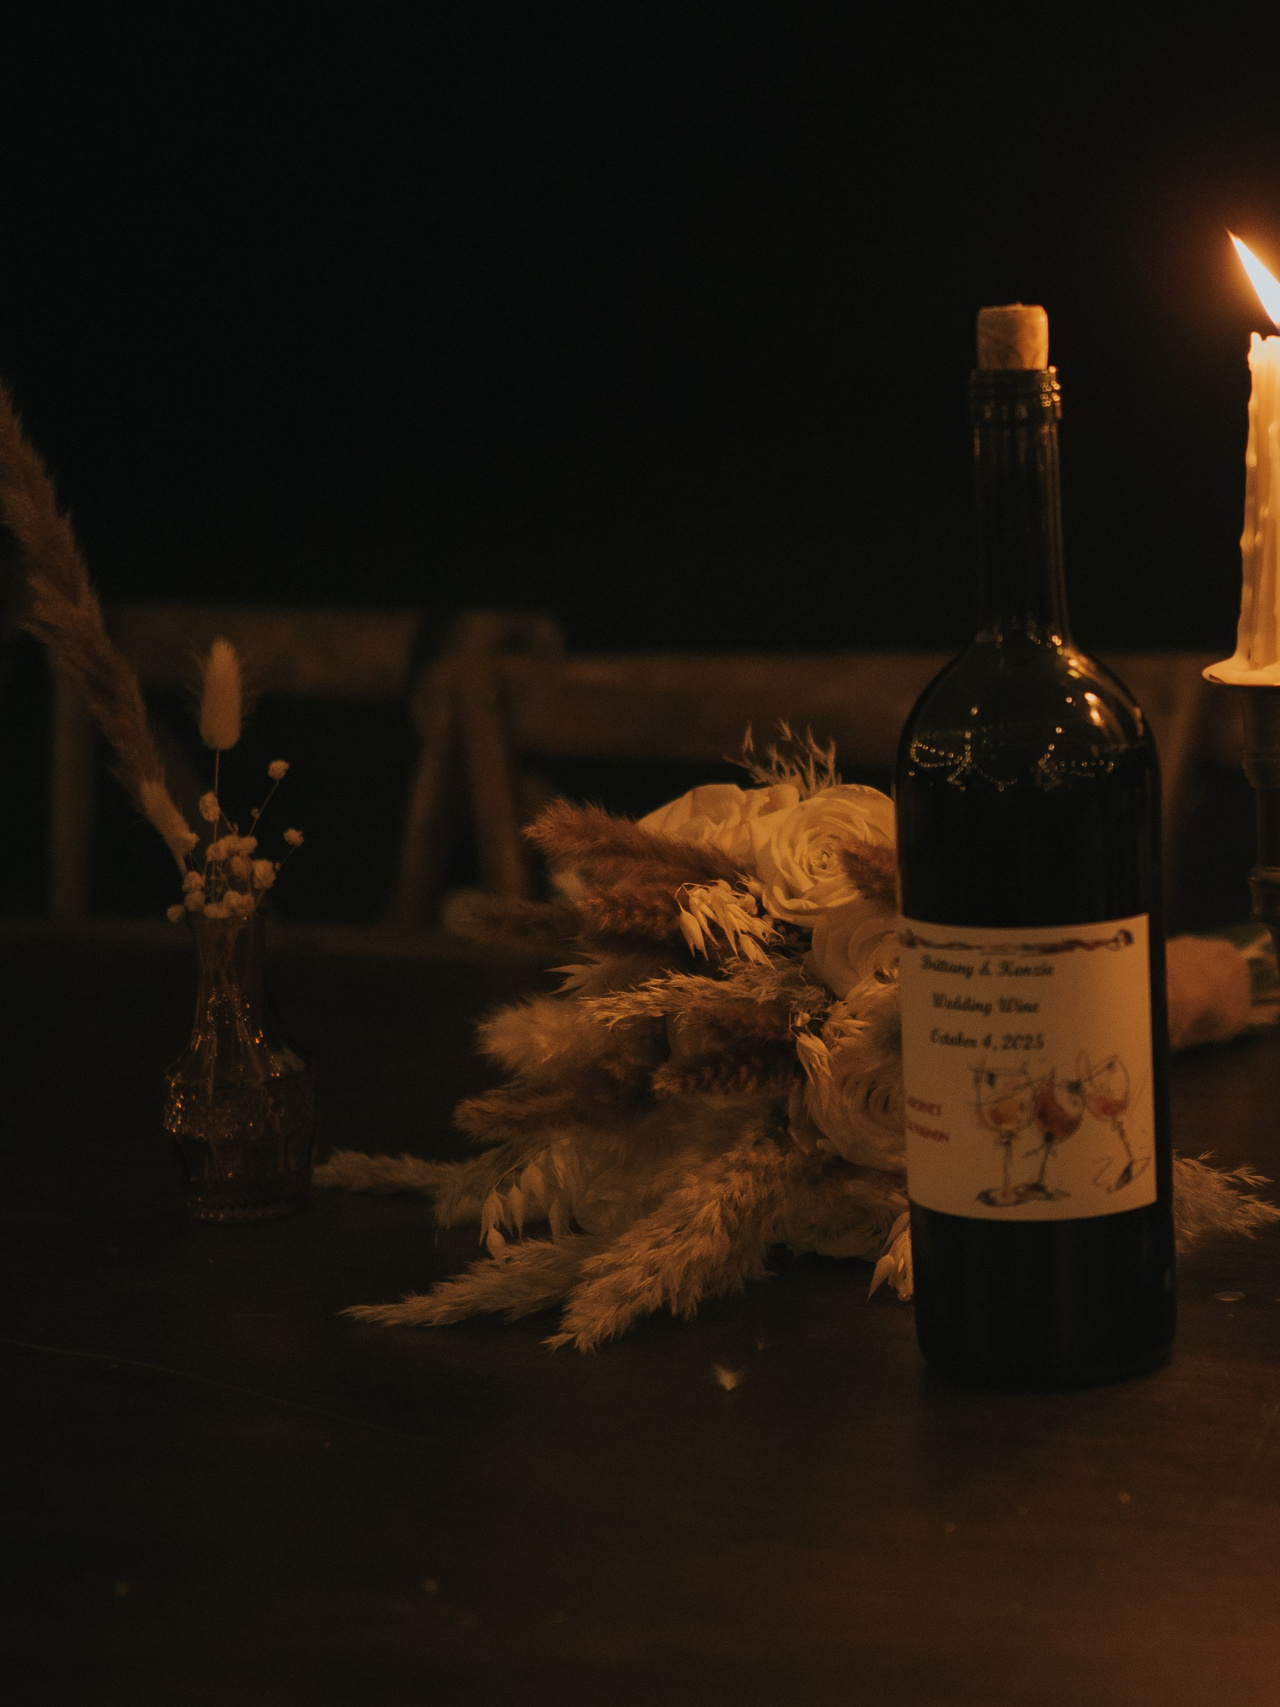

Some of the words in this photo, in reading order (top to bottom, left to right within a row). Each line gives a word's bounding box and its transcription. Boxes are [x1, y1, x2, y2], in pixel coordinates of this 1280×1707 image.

[922, 955, 974, 978] Brittany
[980, 961, 991, 976] &
[932, 992, 992, 1017] Wedding
[998, 997, 1040, 1014] Wine
[930, 1028, 977, 1049] October
[1002, 1033, 1045, 1051] 2025
